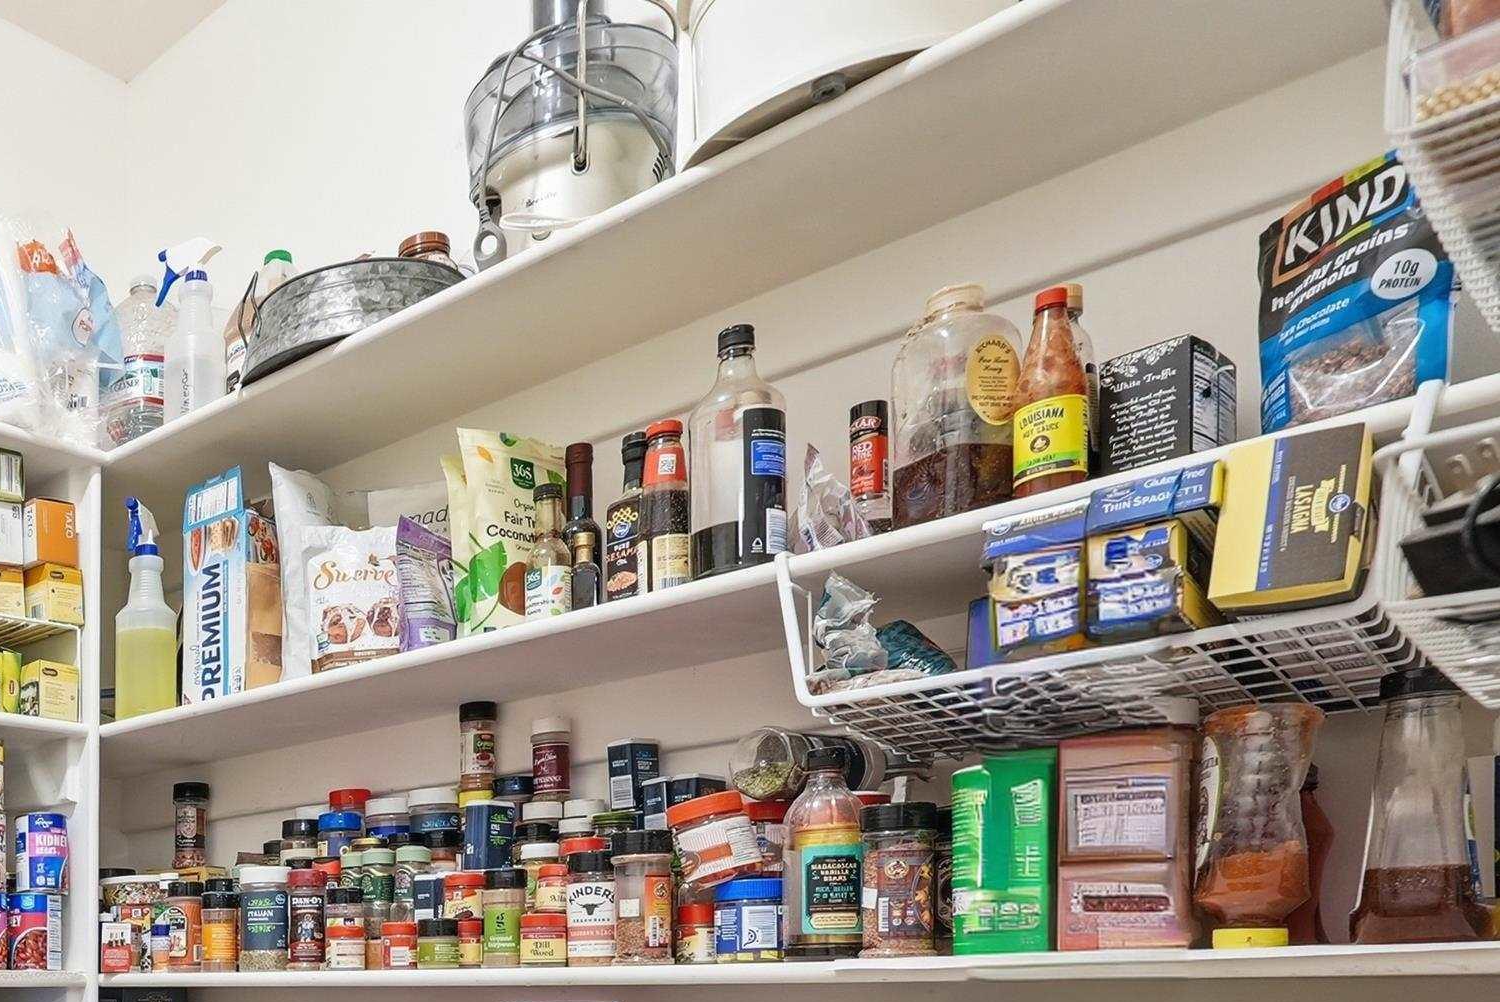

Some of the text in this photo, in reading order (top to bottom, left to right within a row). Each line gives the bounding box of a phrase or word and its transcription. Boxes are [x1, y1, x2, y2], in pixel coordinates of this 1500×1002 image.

[1284, 164, 1407, 267] KIND
[1333, 225, 1409, 265] grains
[1394, 259, 1420, 276] 10g
[1379, 277, 1421, 289] PROTEIN
[504, 510, 524, 526] Fair
[1102, 498, 1131, 515] THIN
[1293, 484, 1310, 535] LASAGNA
[313, 560, 398, 591] Swerve
